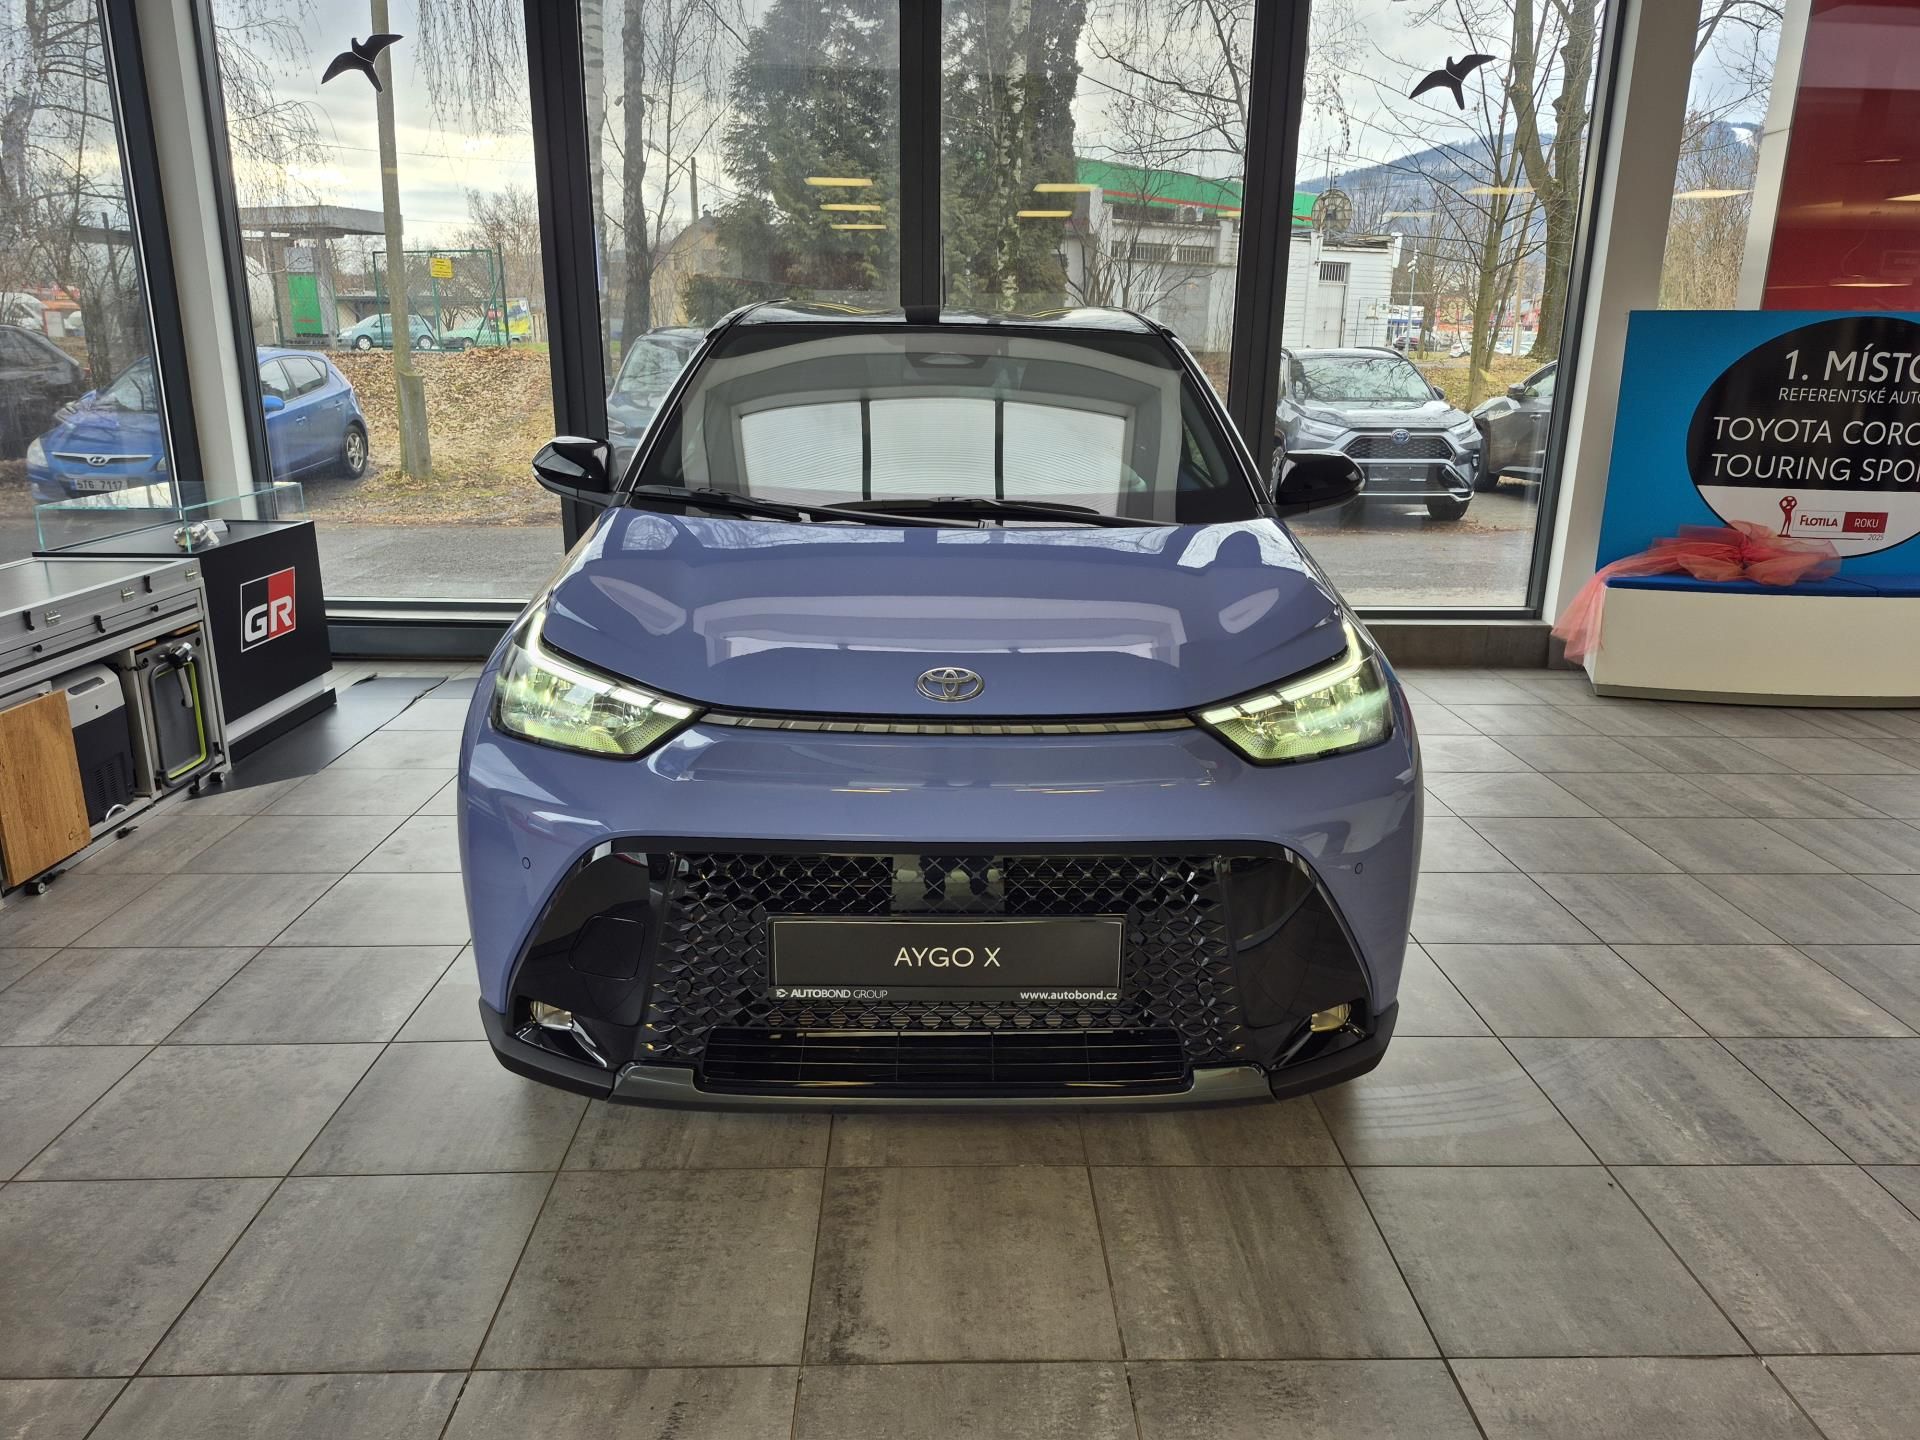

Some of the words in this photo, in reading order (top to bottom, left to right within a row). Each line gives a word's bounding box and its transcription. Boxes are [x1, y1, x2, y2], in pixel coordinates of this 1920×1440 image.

[1785, 349, 1808, 380] 1.
[1779, 386, 1887, 404] REFERENTSKÉ
[1888, 390, 1920, 405] AUT
[1713, 416, 1832, 444] TOYOTA
[1711, 453, 1851, 482] TOURING
[1859, 458, 1920, 483] SPO
[1854, 518, 1880, 528] ROKU
[244, 595, 293, 643] GR
[893, 946, 975, 968] AYGO
[983, 947, 1001, 968] X
[790, 988, 851, 999] AUTOBOND
[853, 989, 888, 999] GROUP
[1020, 990, 1118, 1000] www.autobond.cz
